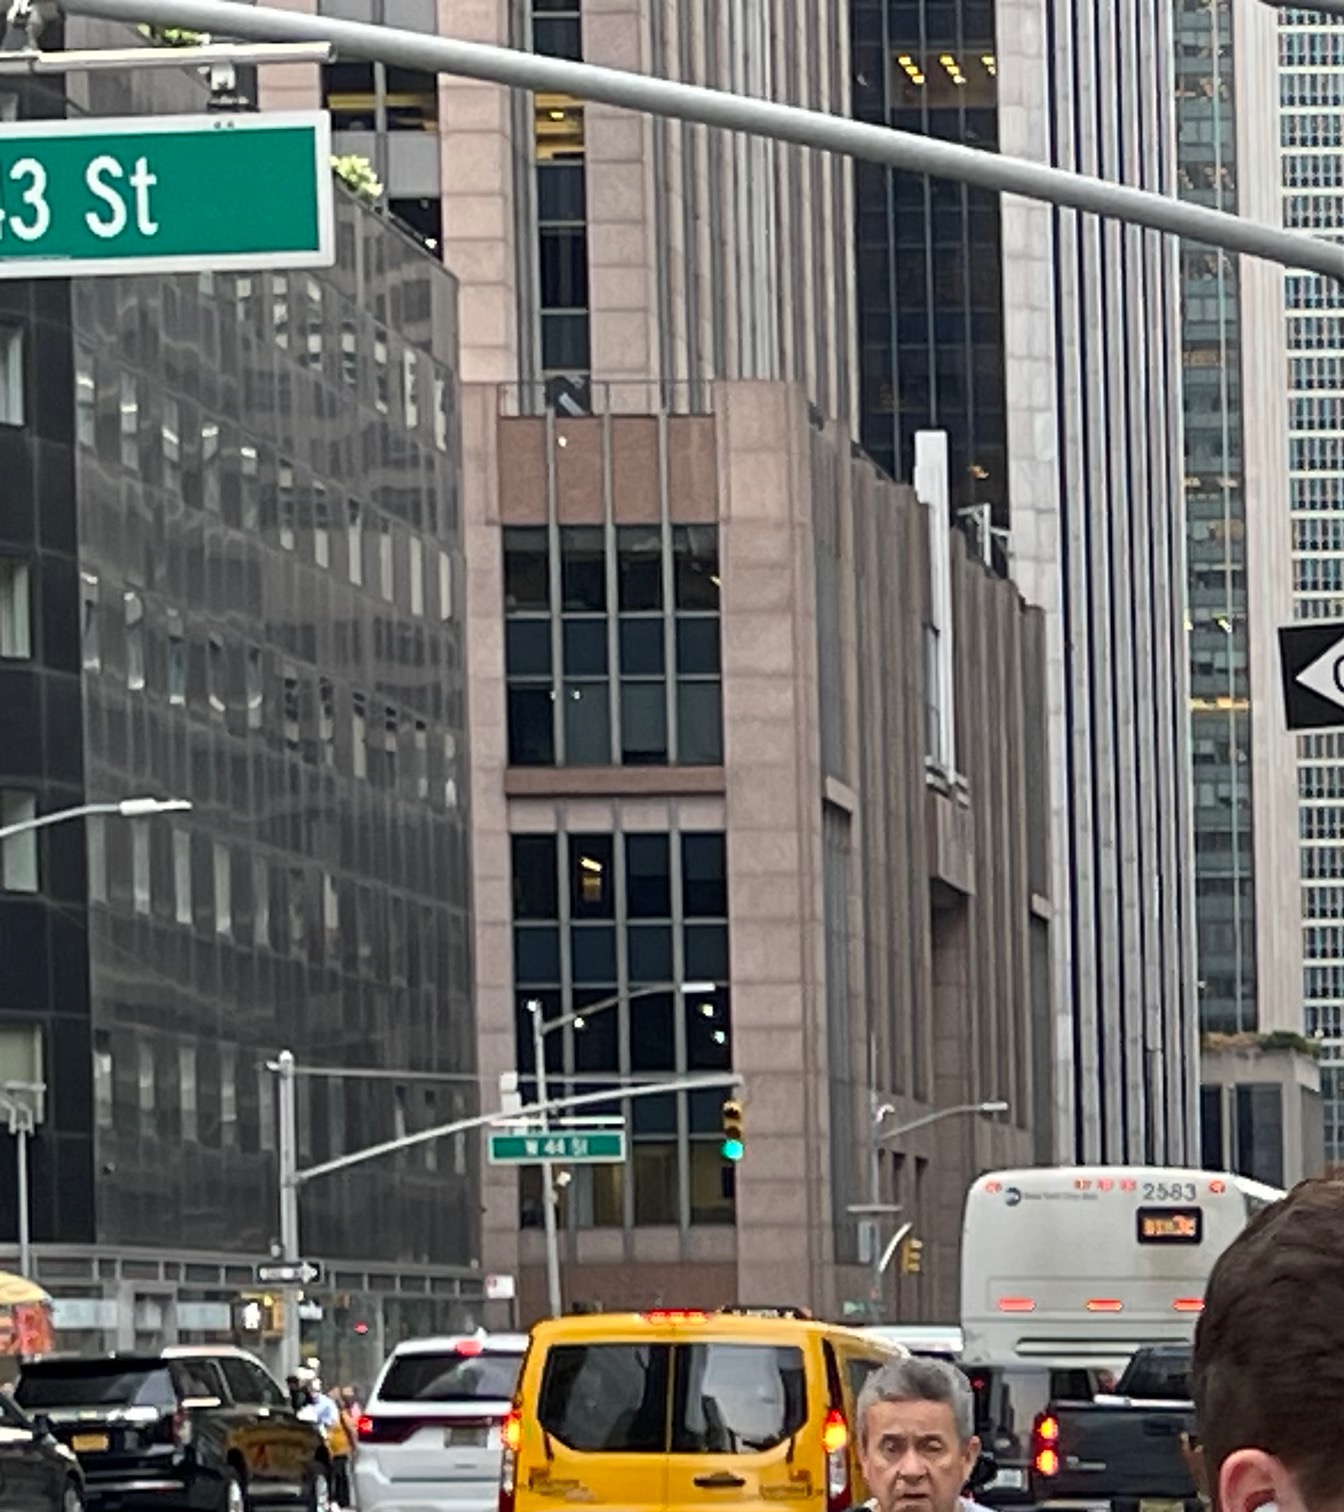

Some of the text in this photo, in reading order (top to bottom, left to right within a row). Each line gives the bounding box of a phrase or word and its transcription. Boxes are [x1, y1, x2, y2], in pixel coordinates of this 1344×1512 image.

[0, 155, 159, 241] 3 St
[1142, 1183, 1197, 1201] 2583
